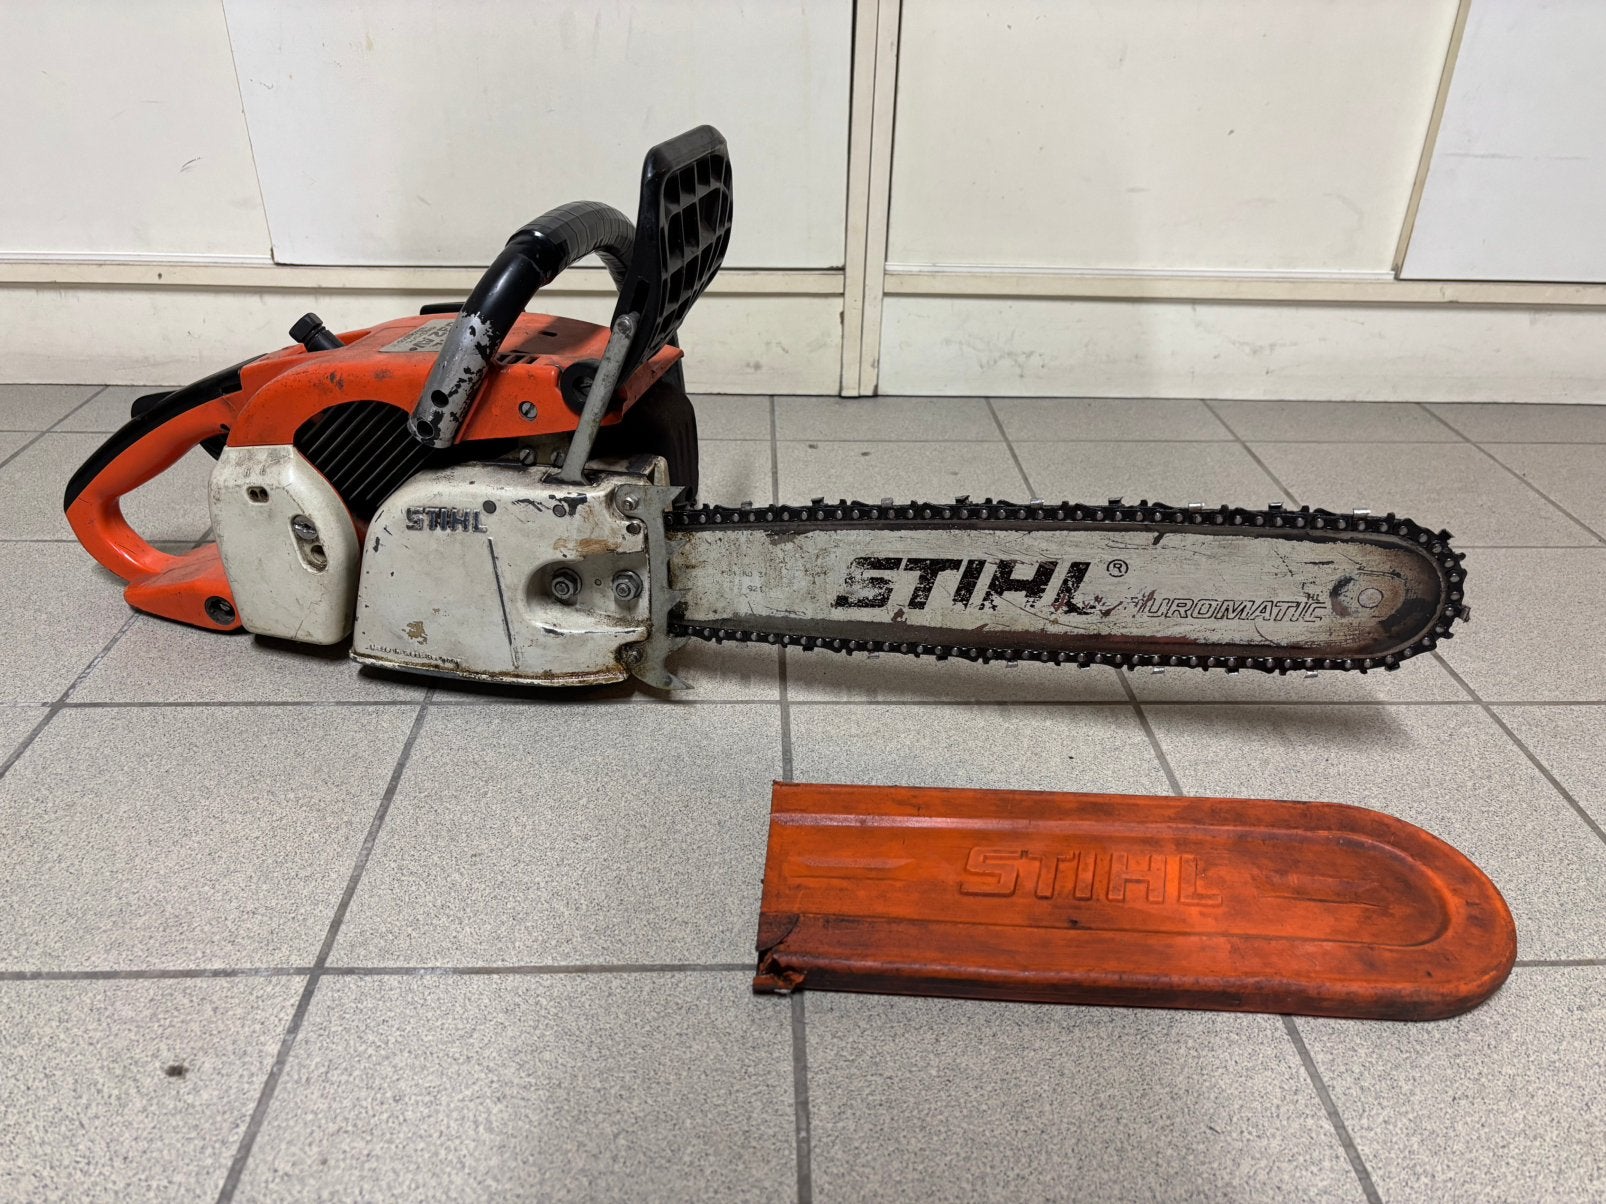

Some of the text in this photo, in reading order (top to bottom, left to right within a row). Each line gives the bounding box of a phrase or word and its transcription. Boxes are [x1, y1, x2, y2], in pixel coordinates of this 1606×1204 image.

[406, 506, 488, 533] STIHL
[831, 556, 1092, 616] STIHL
[960, 846, 1223, 905] STIHL
